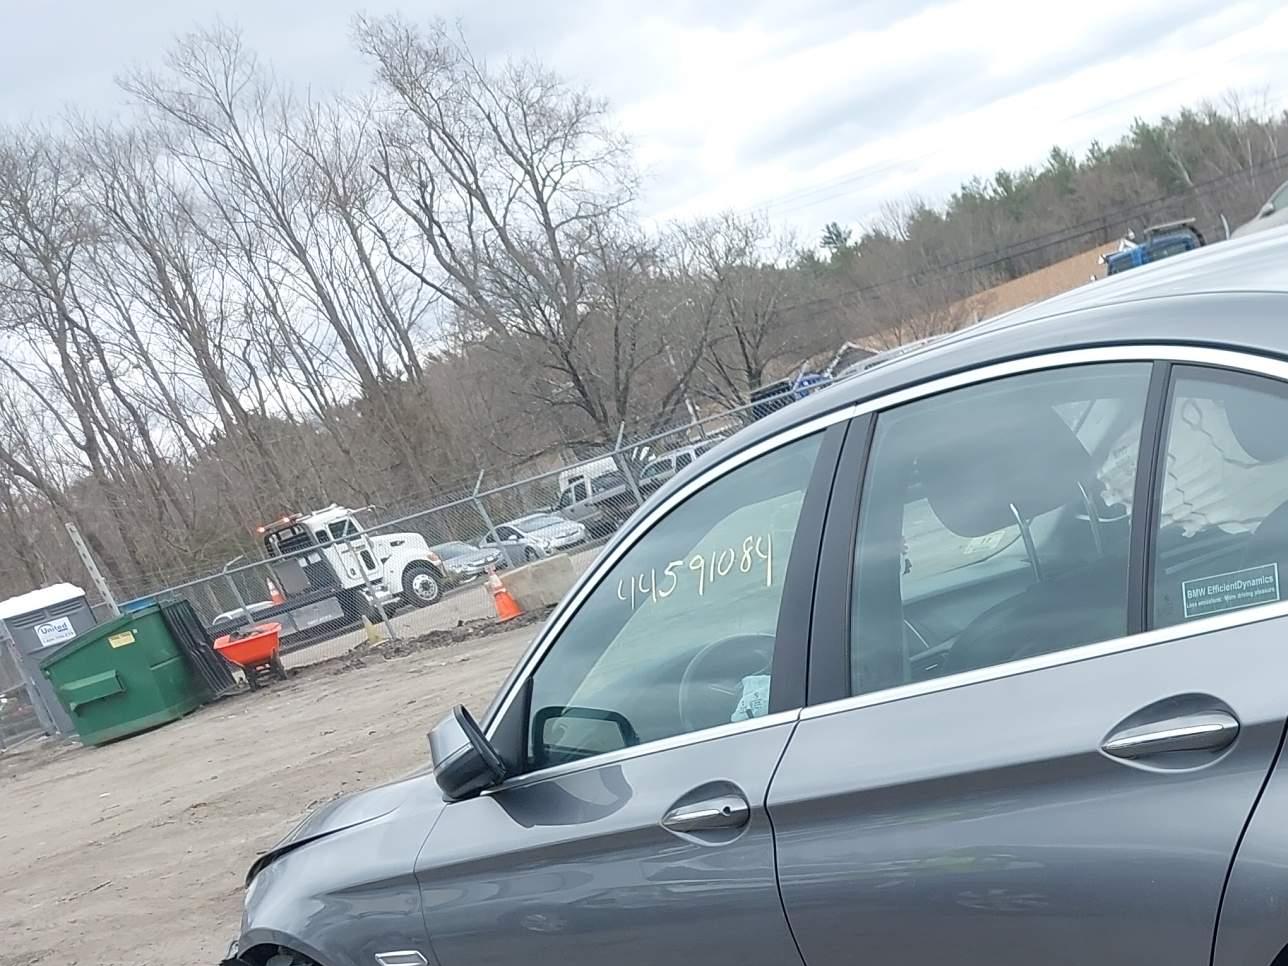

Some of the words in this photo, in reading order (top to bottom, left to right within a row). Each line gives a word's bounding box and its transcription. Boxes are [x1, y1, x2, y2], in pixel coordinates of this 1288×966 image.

[617, 532, 773, 609] 44591084
[1187, 587, 1205, 599] BMW
[1207, 575, 1273, 595] EfficientDynamics
[40, 622, 68, 634] United
